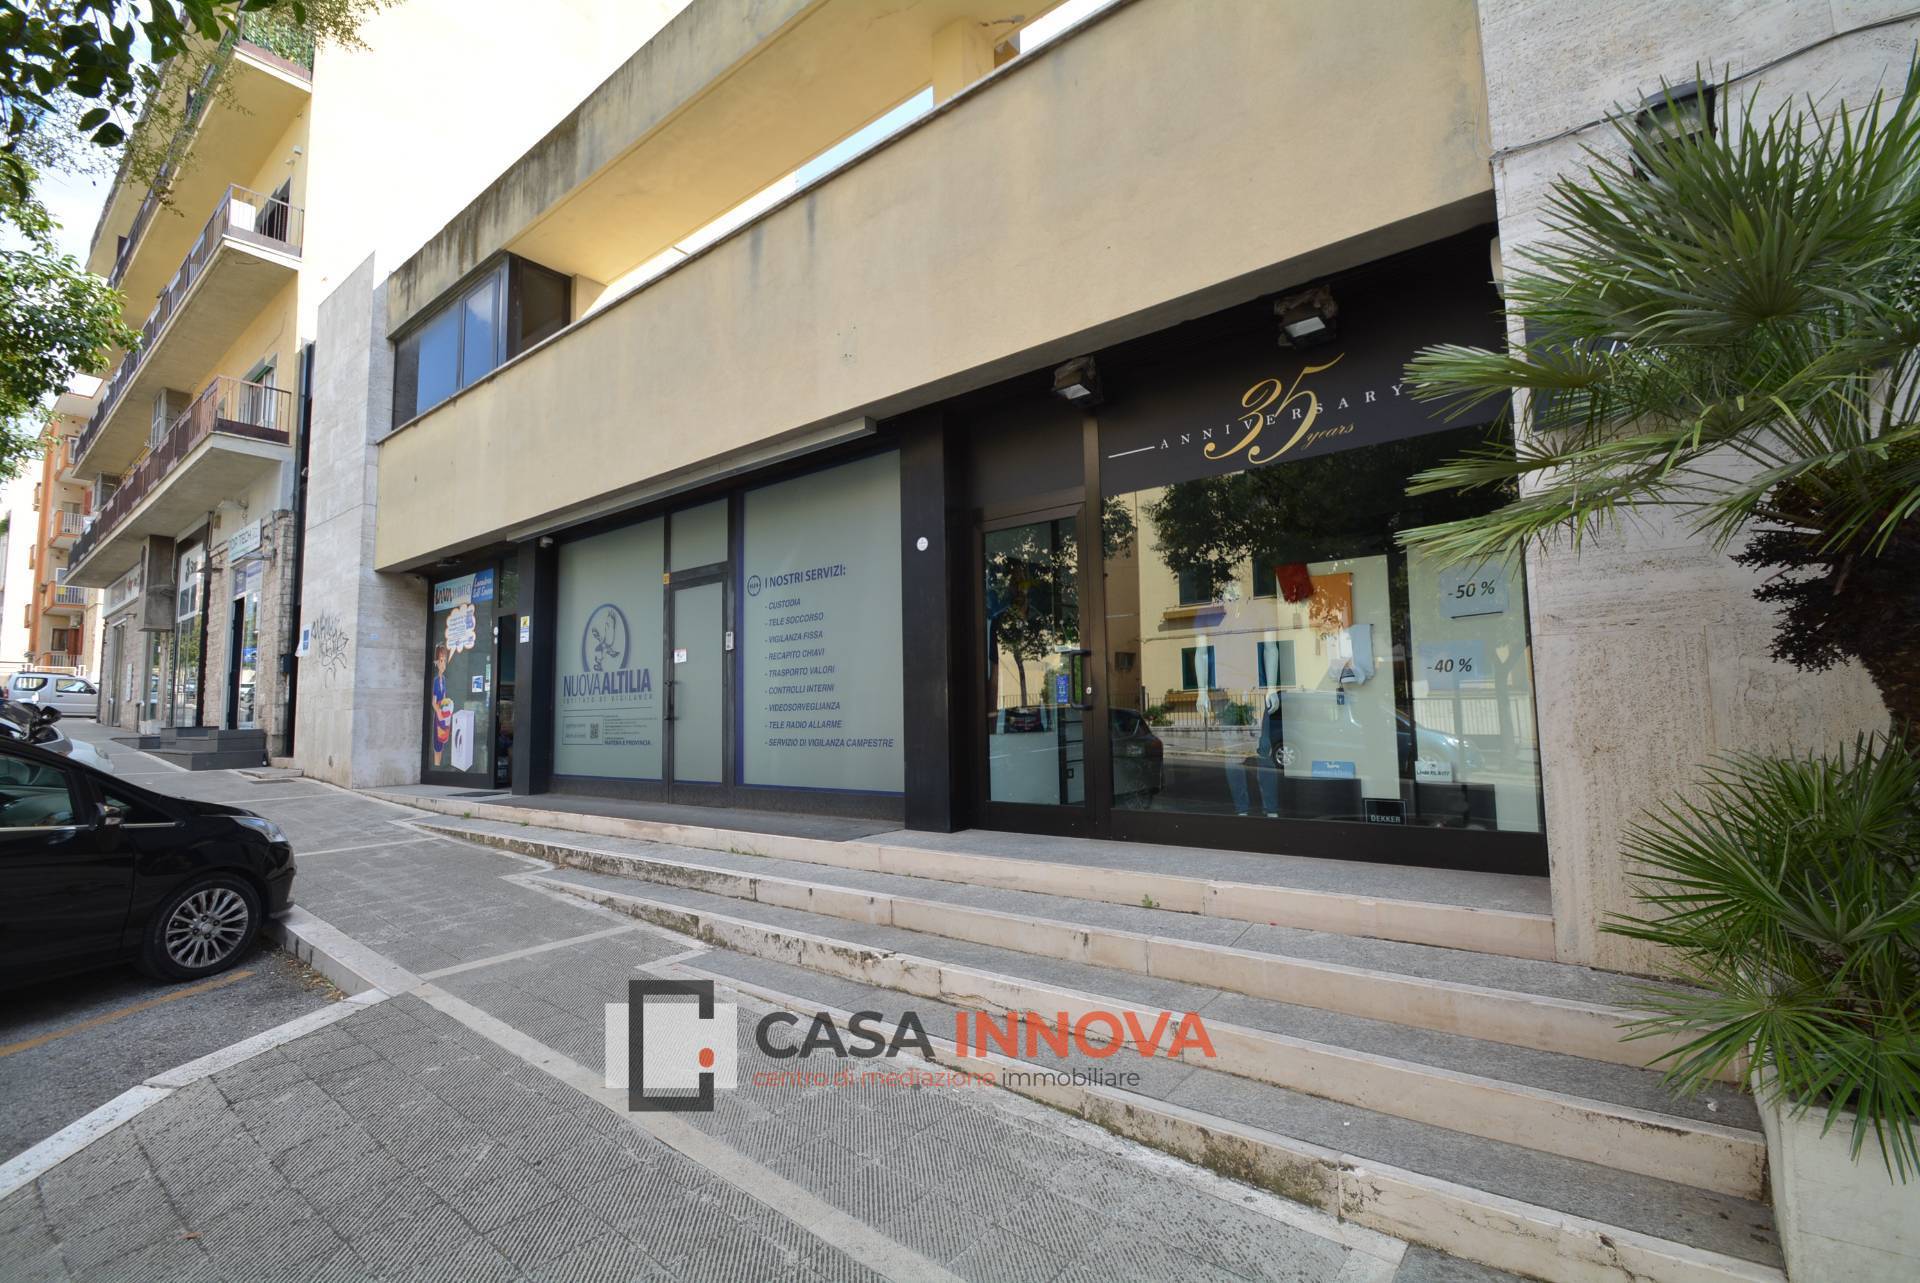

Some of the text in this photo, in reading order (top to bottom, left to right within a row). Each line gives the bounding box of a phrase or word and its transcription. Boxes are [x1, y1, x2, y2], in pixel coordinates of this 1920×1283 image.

[1204, 352, 1345, 465] 35
[1160, 384, 1403, 450] ANNIVERSARY
[1302, 422, 1355, 450] years
[765, 577, 768, 589] I
[769, 571, 803, 587] NOSTRI
[805, 564, 846, 581] SERVIZI:
[768, 598, 801, 610] CUSTODIA
[768, 612, 824, 627] TELE SOCCORSO
[768, 630, 823, 644] VIGILANZA FISSA
[768, 648, 825, 661] RECAPITO CHIAVI
[768, 665, 835, 678] TRASPORTO VALORI
[563, 668, 652, 697] NUOVA ALTILIA
[768, 683, 835, 695] CONTROLLI INTERNI
[768, 702, 840, 712] VIDEOSORVEGLIANZA
[768, 720, 843, 729] TELE RADIO ALLARME
[768, 738, 895, 748] SERVIZIO DI VIGILANZA CAMPESTRE
